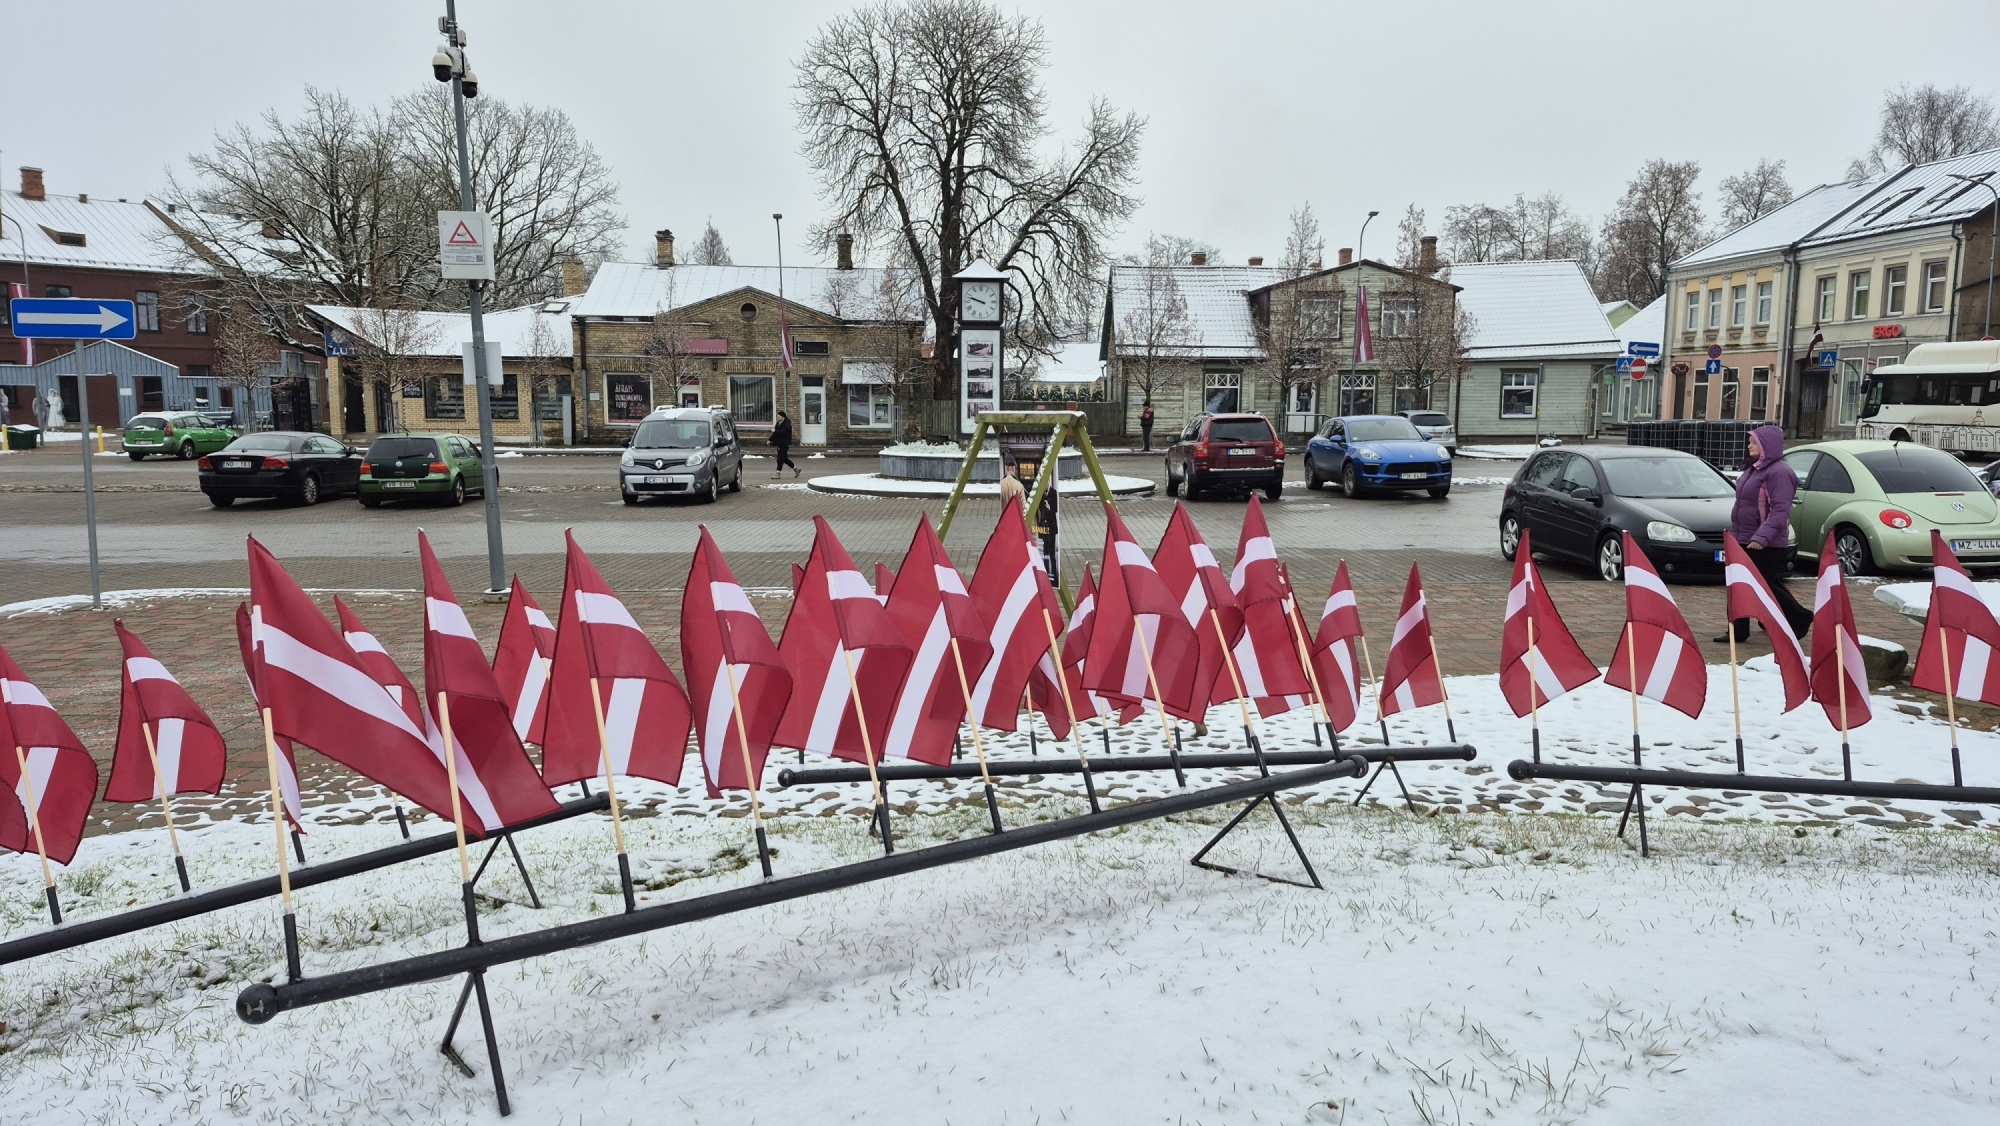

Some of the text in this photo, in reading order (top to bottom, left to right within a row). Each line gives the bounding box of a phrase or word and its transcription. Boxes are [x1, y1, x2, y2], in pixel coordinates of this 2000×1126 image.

[1873, 324, 1901, 338] ERGO
[615, 383, 633, 393] ĀTRAIS
[1015, 434, 1043, 443] BANKA
[1957, 541, 2000, 550] MZ-4444
